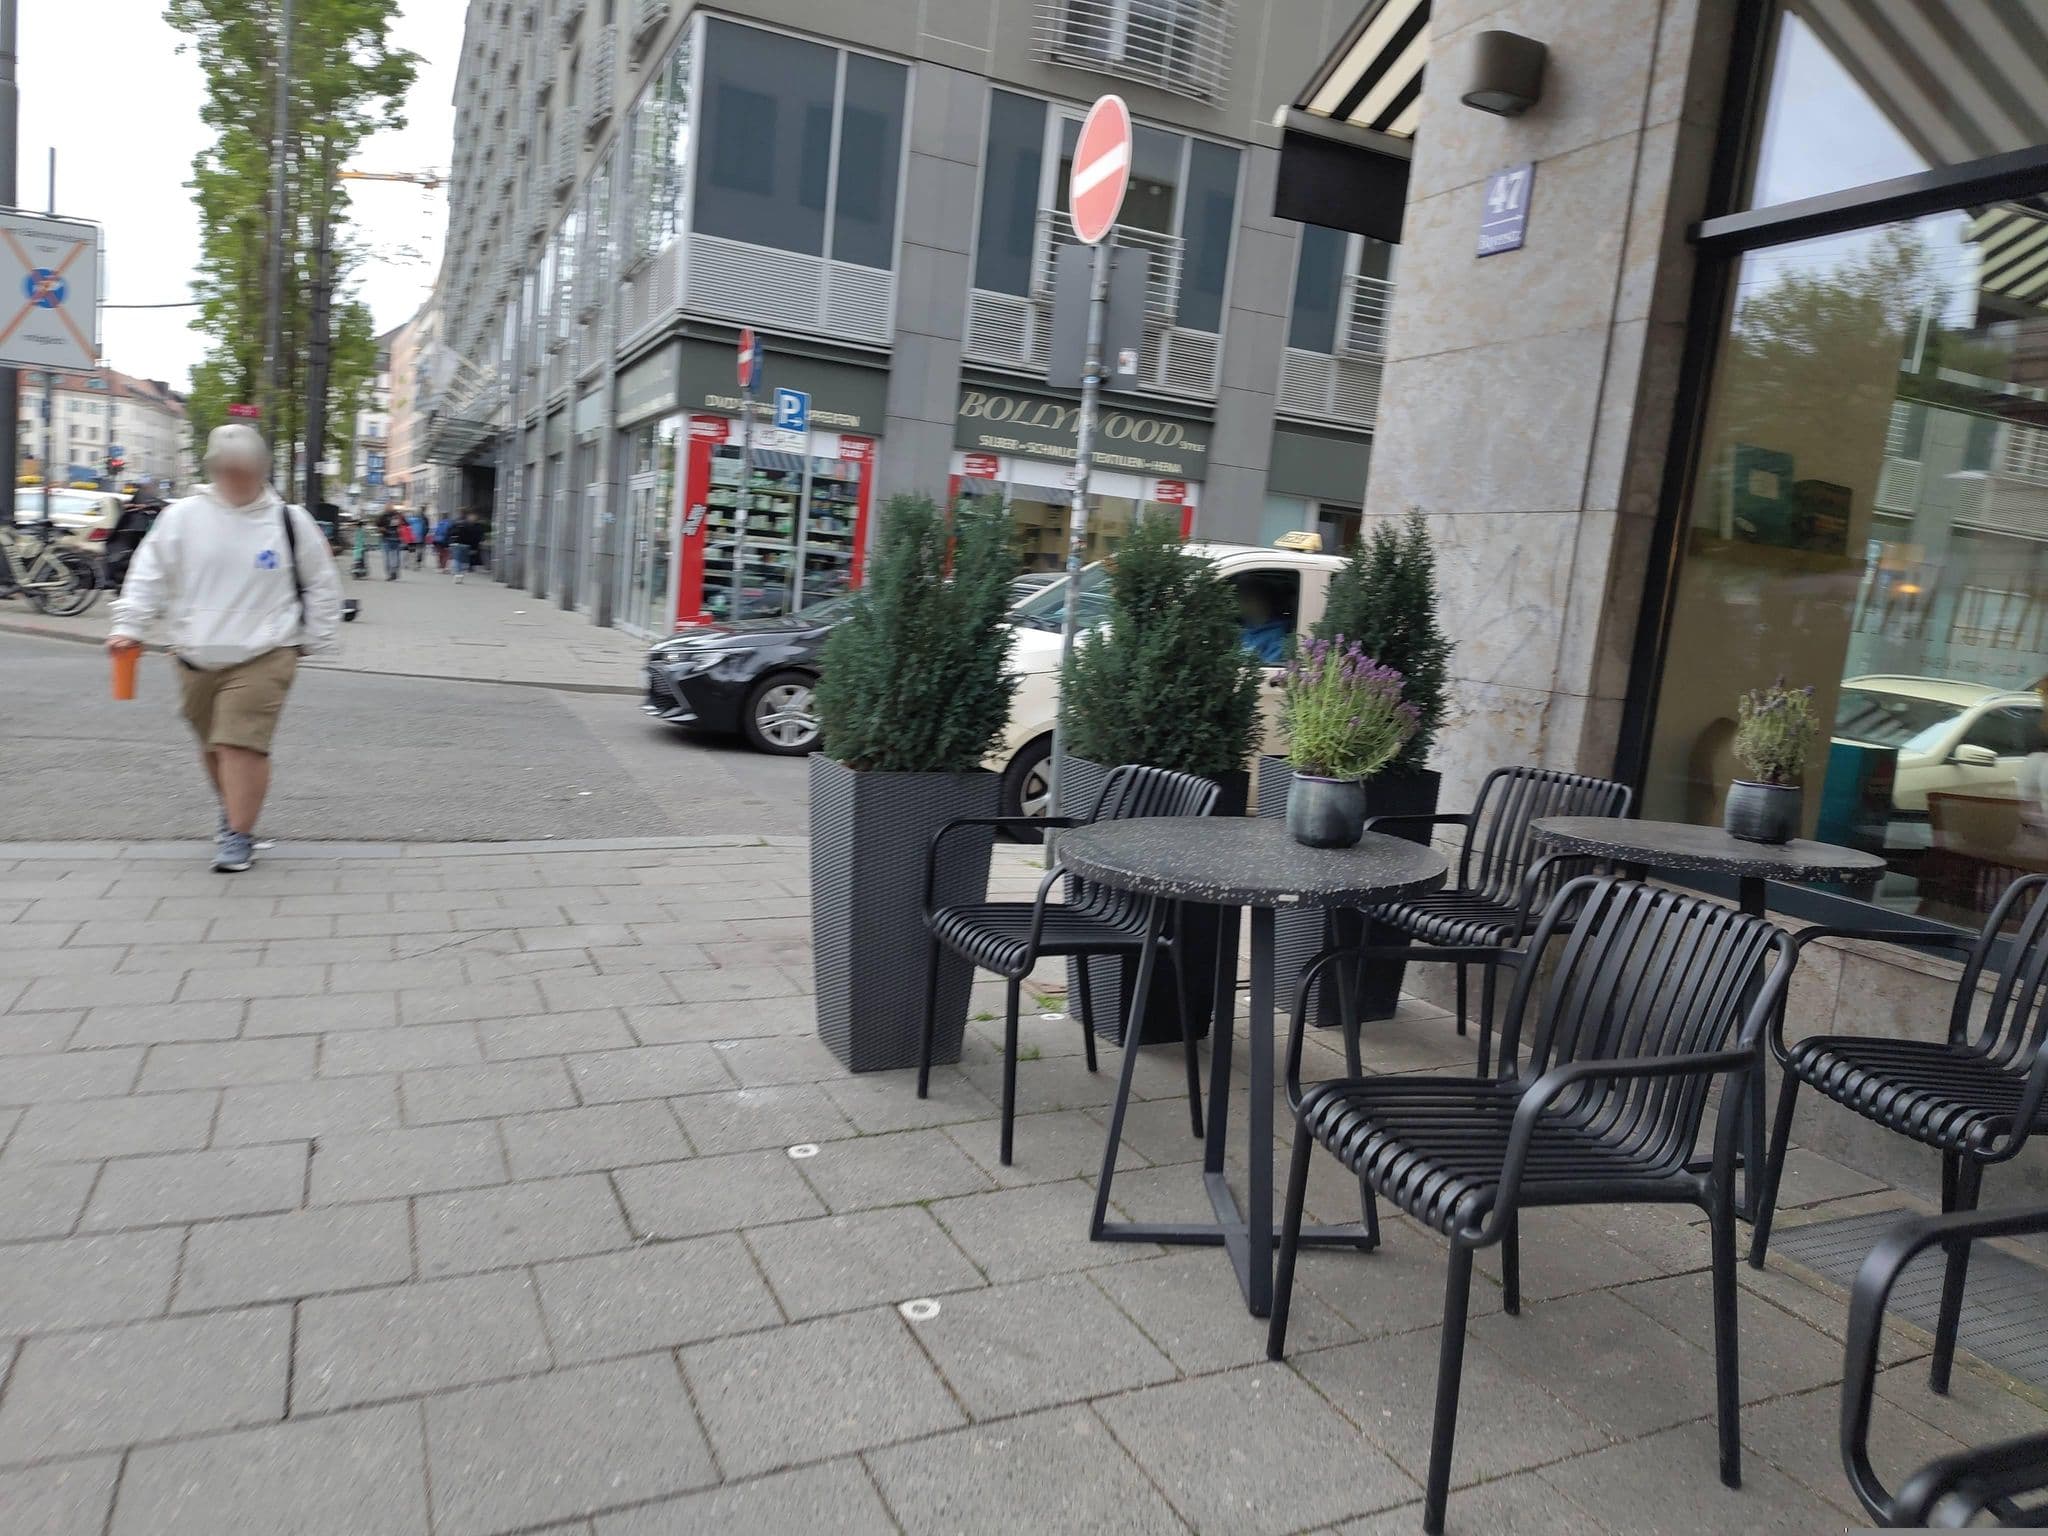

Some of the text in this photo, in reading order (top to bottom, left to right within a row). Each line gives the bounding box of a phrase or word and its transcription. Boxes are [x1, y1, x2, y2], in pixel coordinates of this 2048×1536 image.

[1487, 170, 1526, 214] 47
[778, 394, 801, 423] P
[1025, 441, 1080, 459] SCHMUC
